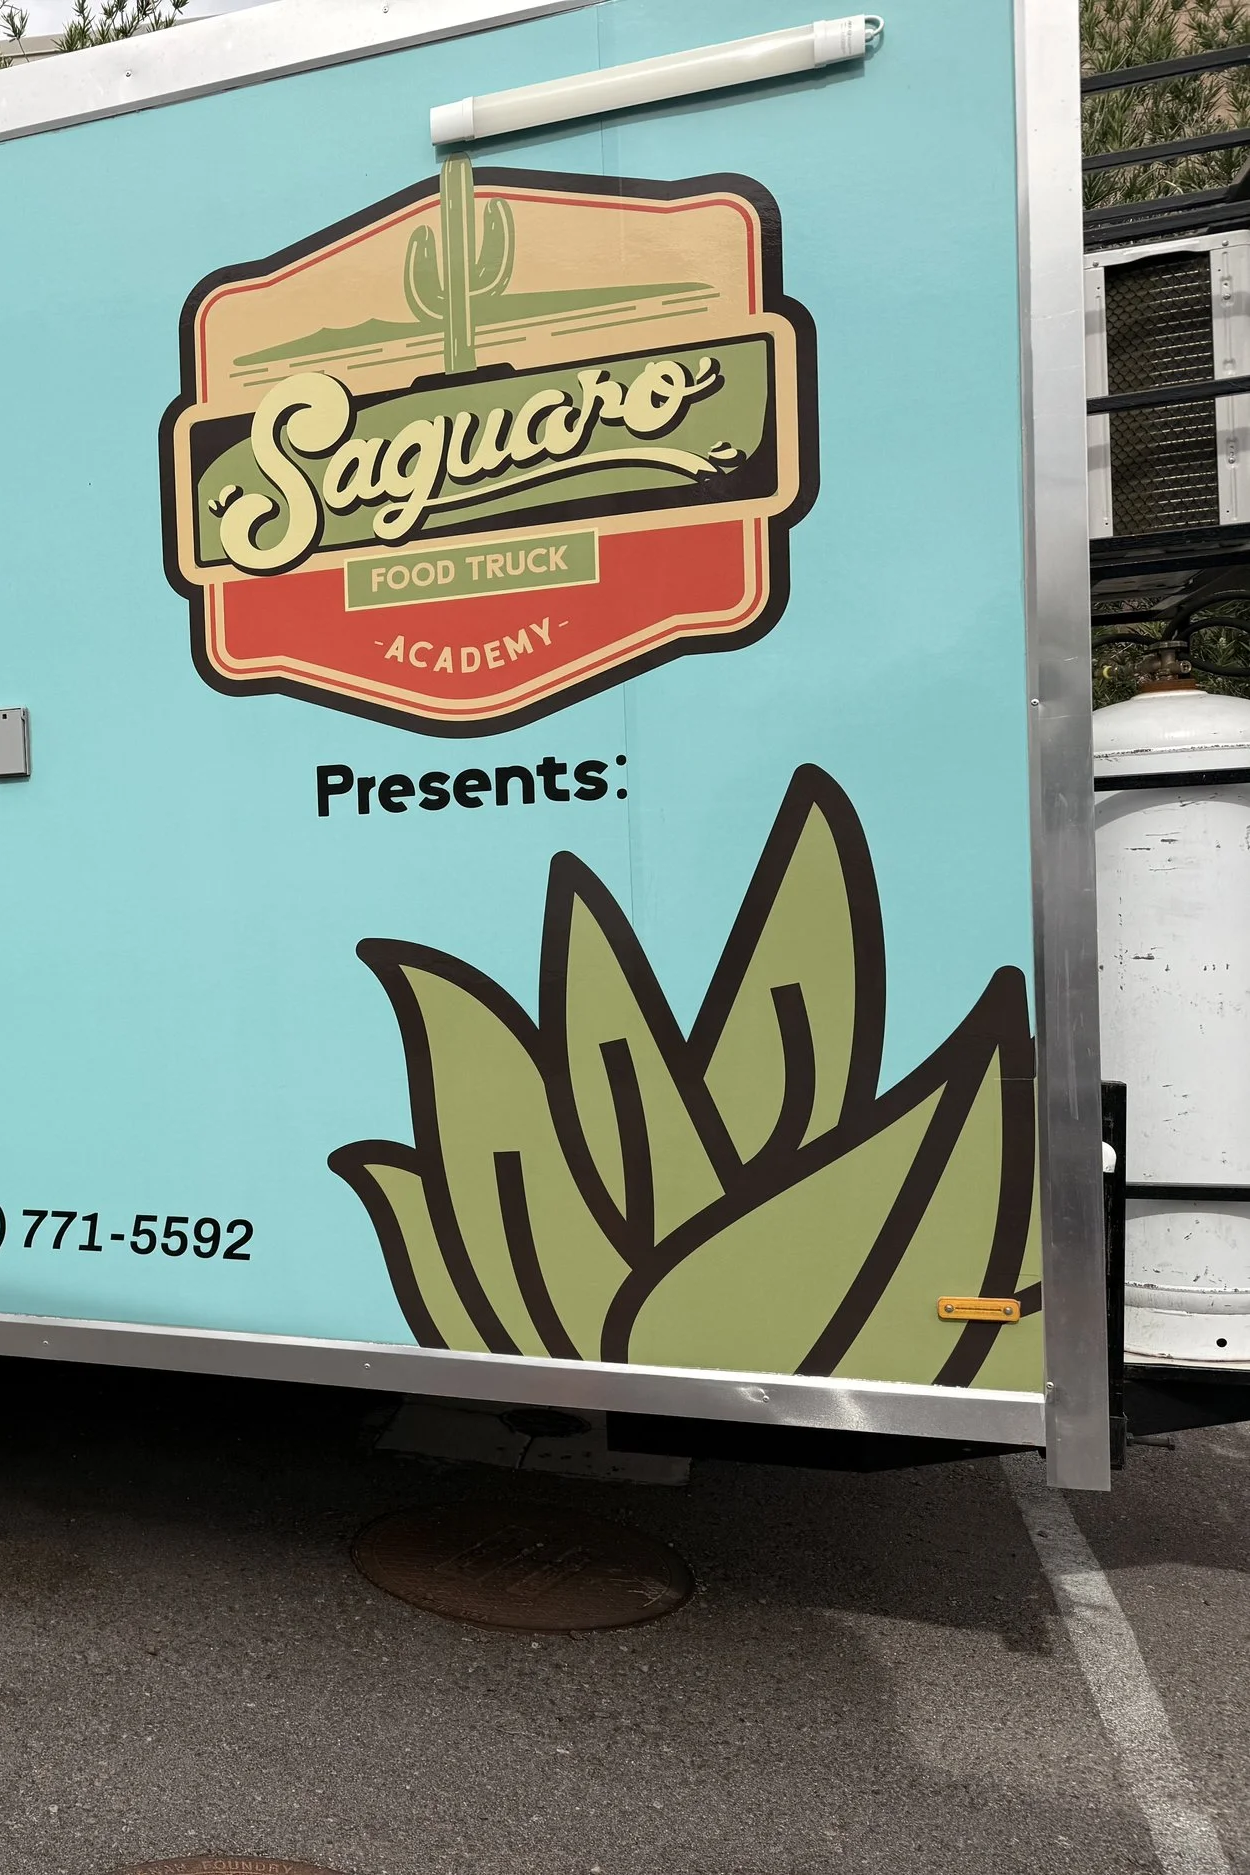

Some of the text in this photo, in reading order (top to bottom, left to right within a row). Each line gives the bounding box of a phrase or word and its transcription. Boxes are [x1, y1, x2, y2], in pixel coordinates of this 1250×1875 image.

[218, 357, 722, 572] Saguaro
[371, 544, 569, 592] FOOD TRUCK
[316, 754, 629, 818] Presents:
[22, 1209, 254, 1261] 771-5592
[201, 1860, 294, 1874] FOUNDRY
